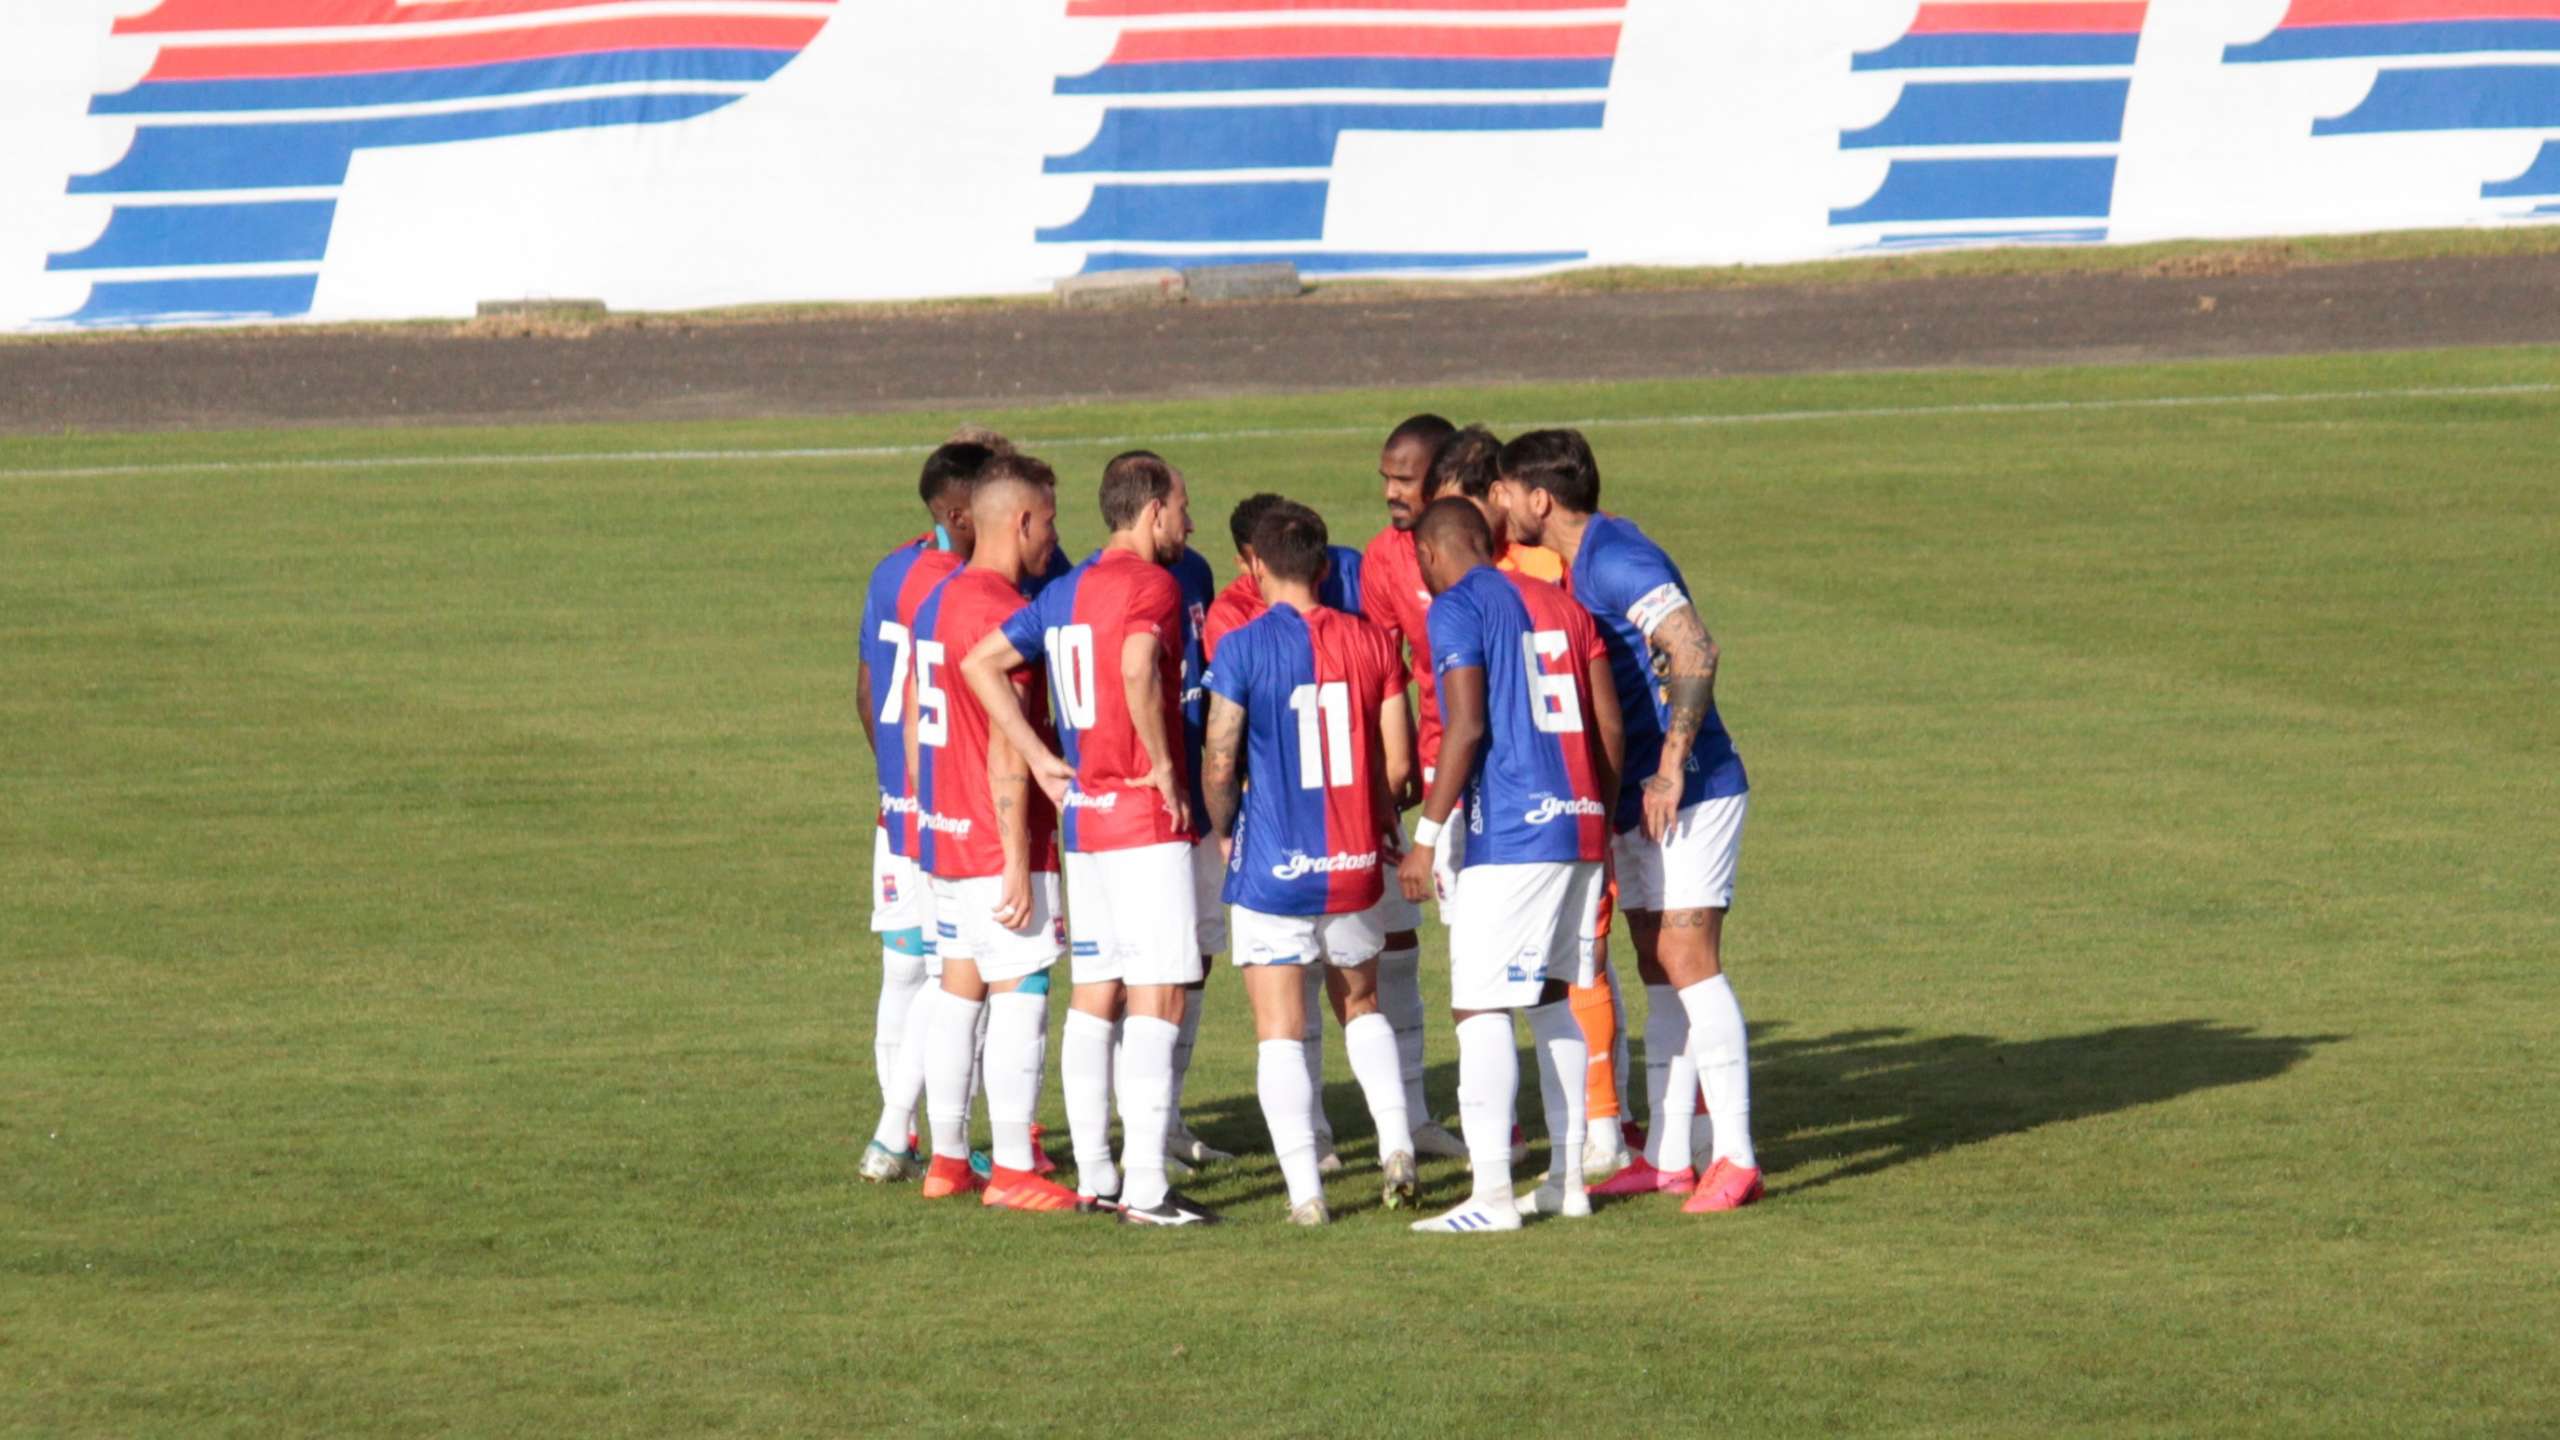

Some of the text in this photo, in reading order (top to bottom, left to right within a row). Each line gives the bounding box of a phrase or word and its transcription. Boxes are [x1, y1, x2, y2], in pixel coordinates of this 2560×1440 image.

[878, 621, 911, 724] 7
[915, 639, 948, 748] 5
[1044, 624, 1096, 730] 10
[1522, 630, 1584, 734] 6
[1289, 682, 1353, 789] 11
